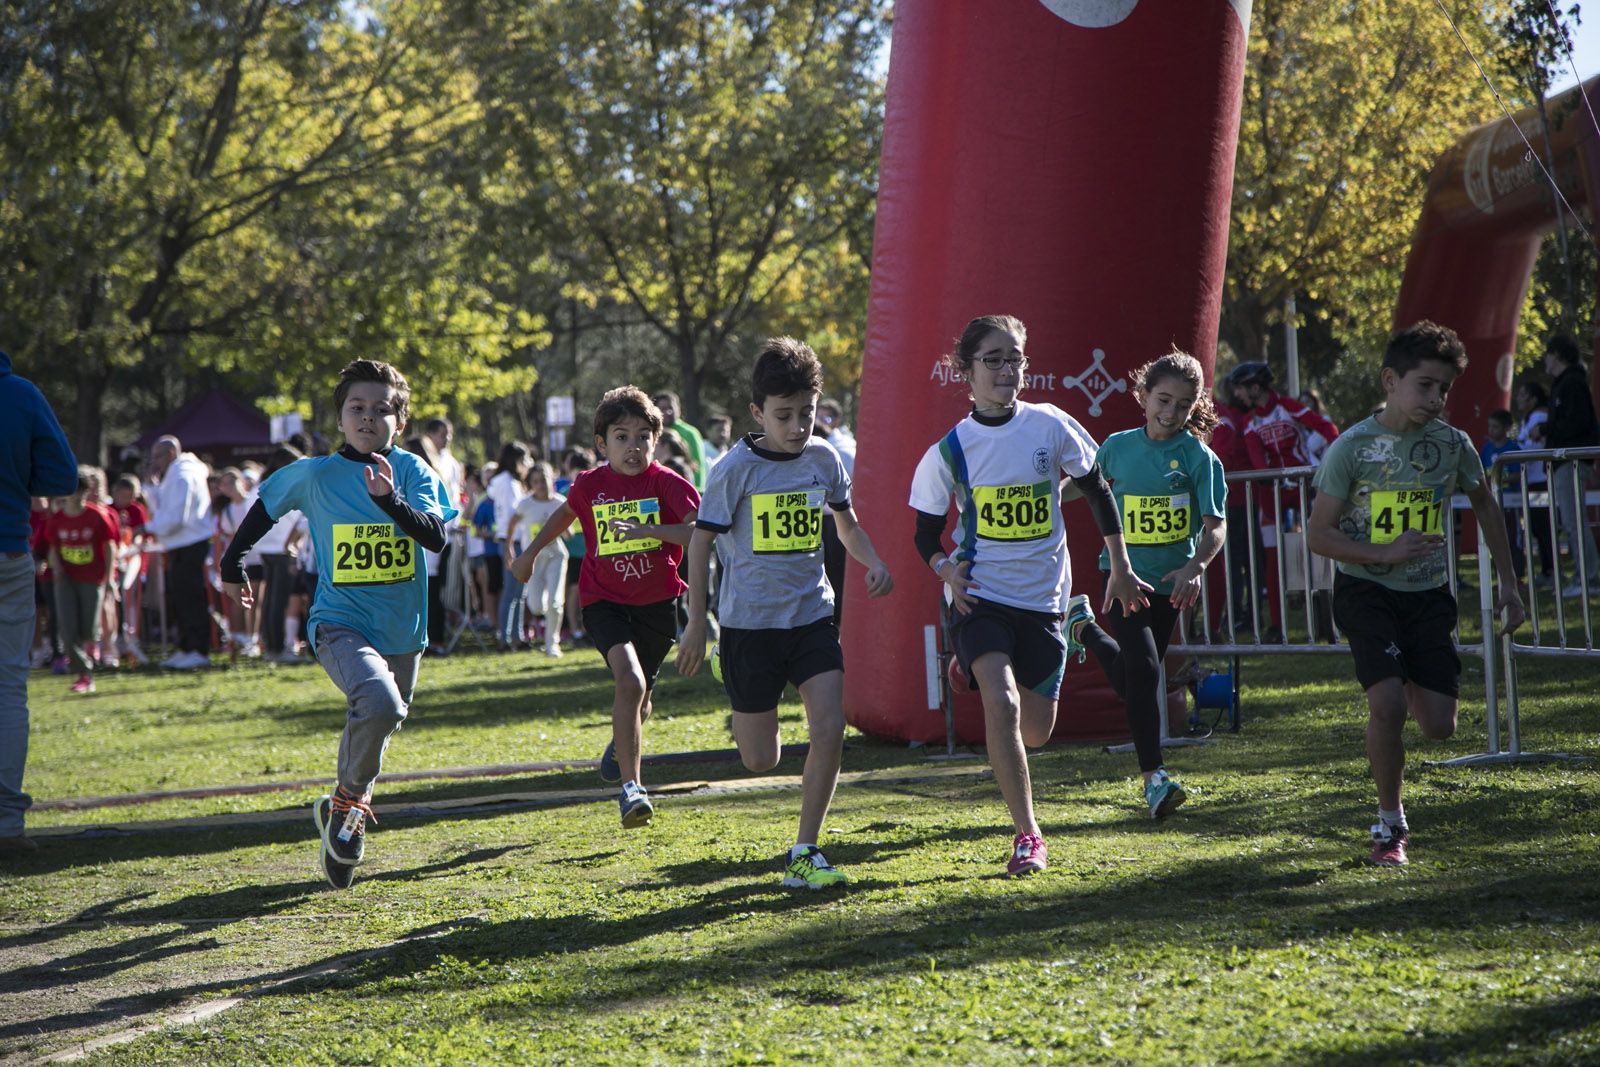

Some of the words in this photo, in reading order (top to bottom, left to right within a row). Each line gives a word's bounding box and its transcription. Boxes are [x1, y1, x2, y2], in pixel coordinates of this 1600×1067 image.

[930, 360, 1056, 391] Ajuent
[775, 495, 784, 507] 19
[997, 488, 1006, 499] 19
[1397, 491, 1407, 503] 19
[757, 508, 820, 538] 1385
[981, 497, 1049, 527] 4308
[1127, 508, 1187, 534] 1533
[354, 526, 364, 538] 19
[336, 539, 411, 570] 2963
